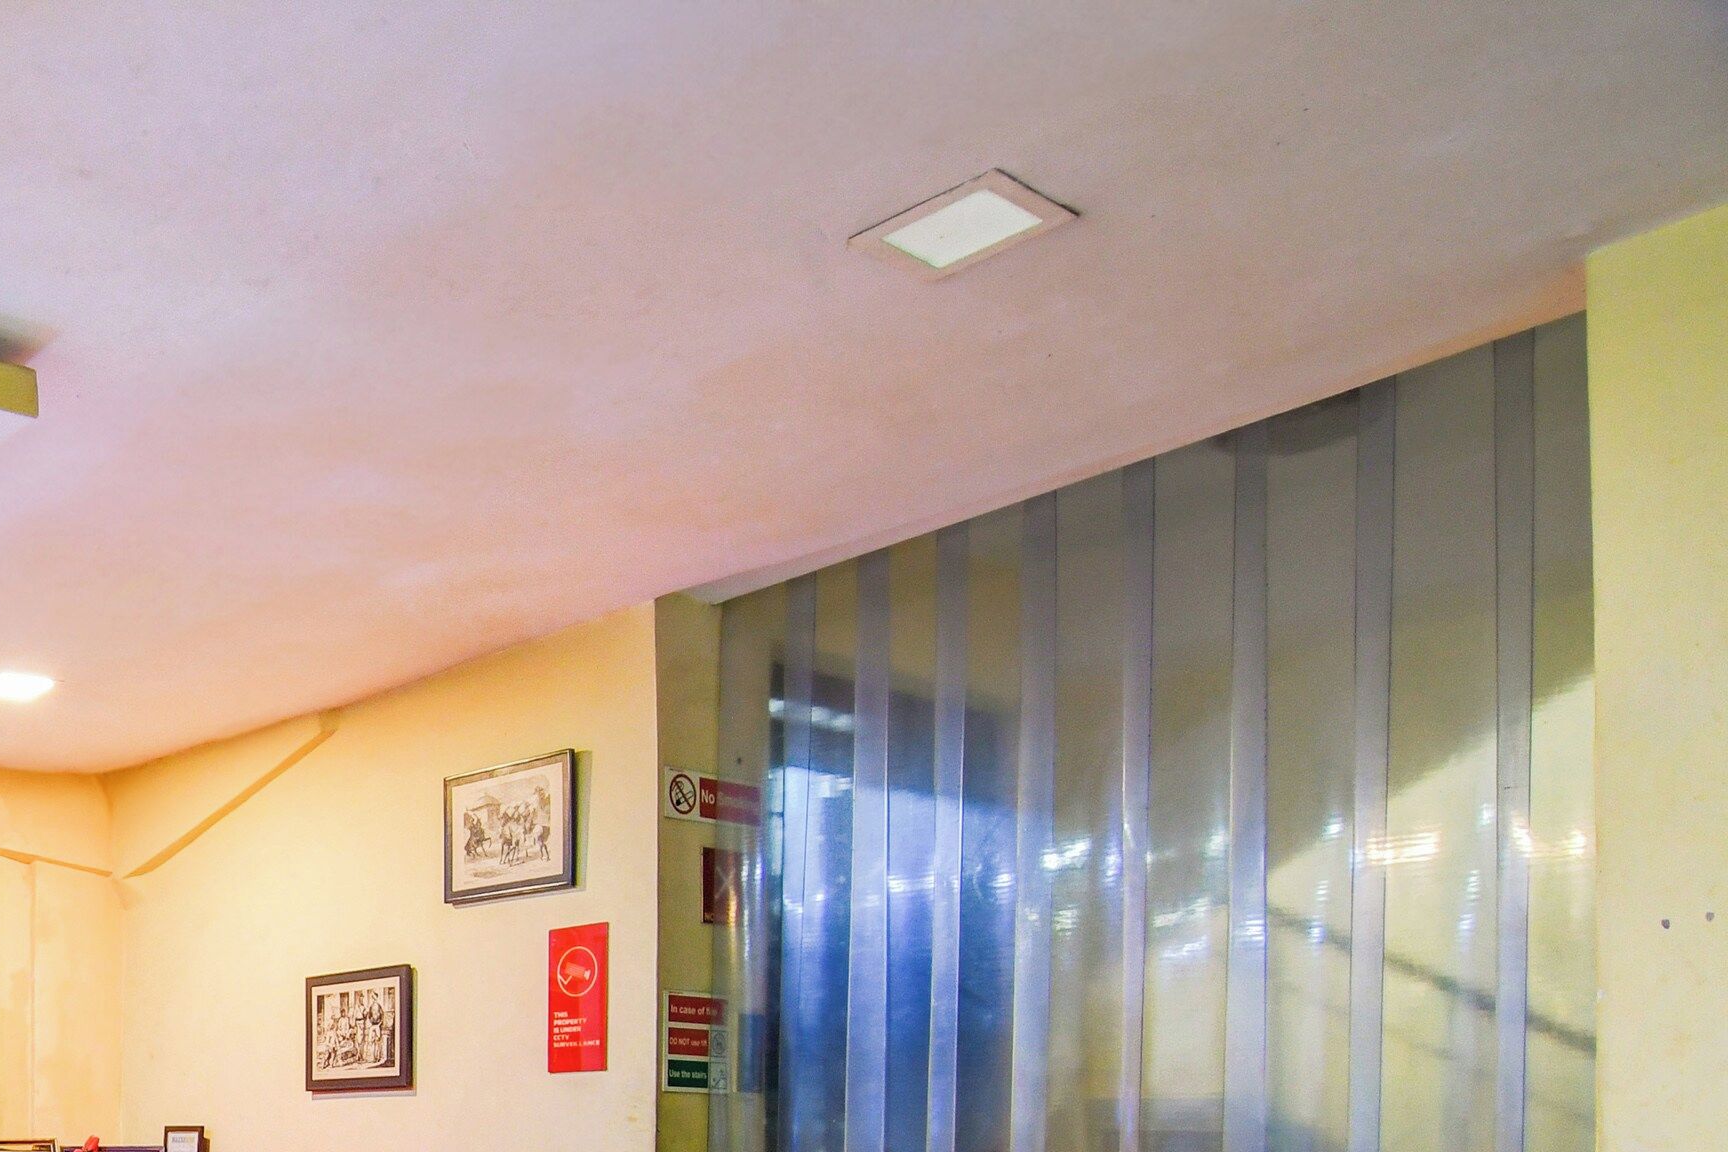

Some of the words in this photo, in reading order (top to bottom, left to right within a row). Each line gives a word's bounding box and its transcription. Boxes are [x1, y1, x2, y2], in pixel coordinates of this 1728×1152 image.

[701, 788, 715, 805] No
[670, 1004, 678, 1013] In
[679, 1006, 696, 1015] case
[697, 1006, 705, 1015] of
[681, 1070, 691, 1079] the
